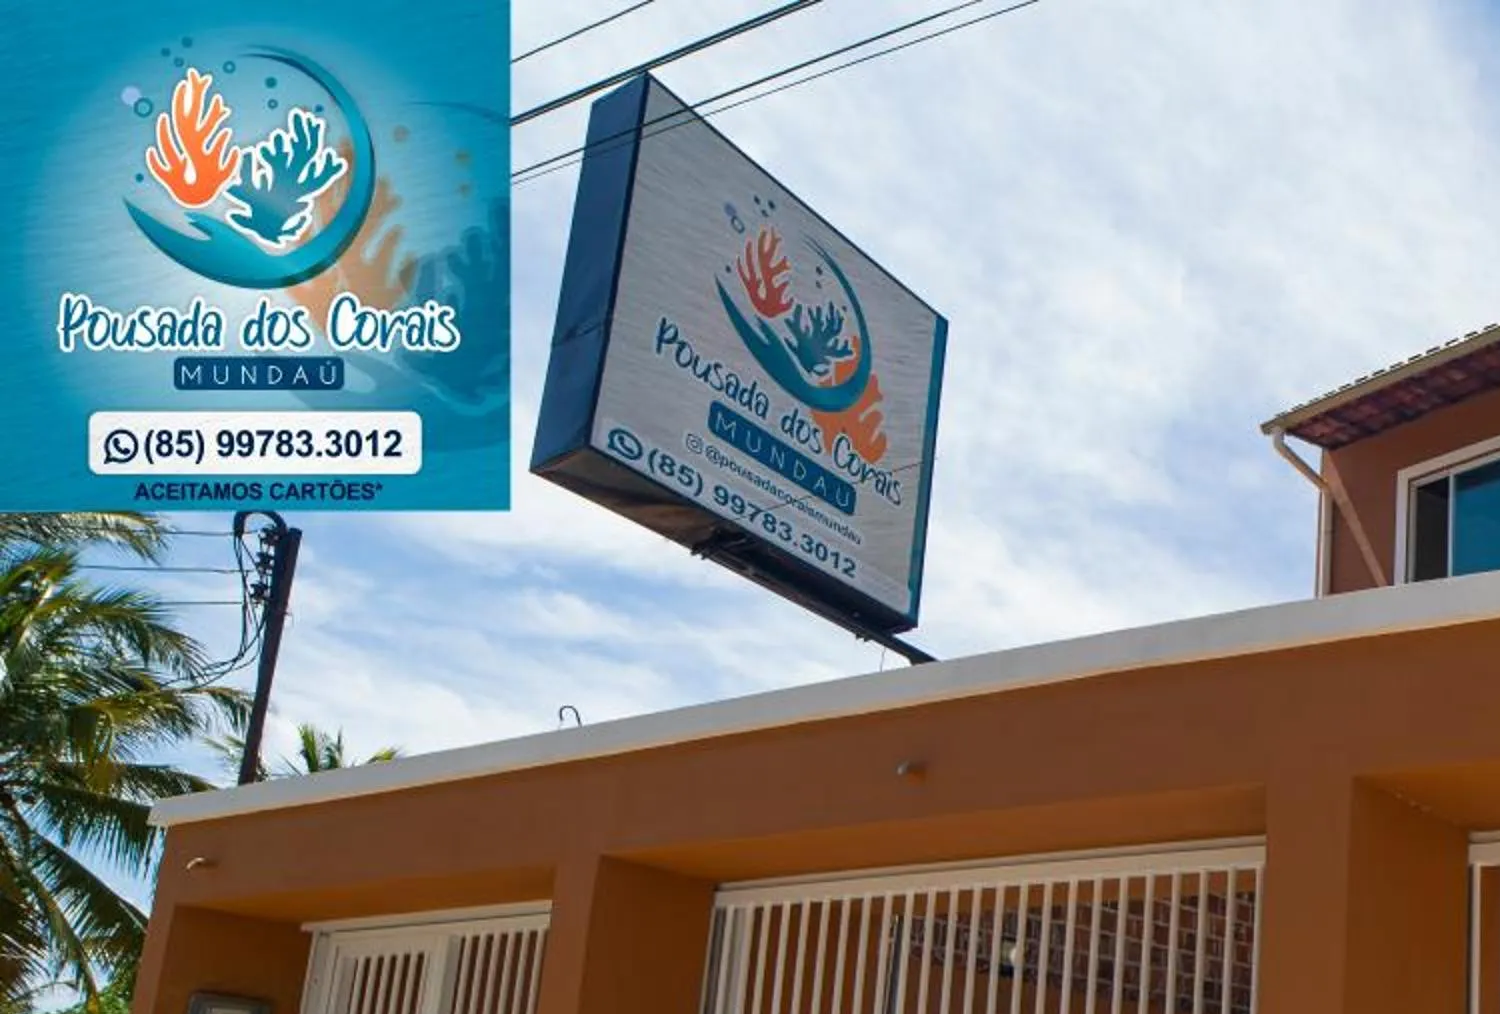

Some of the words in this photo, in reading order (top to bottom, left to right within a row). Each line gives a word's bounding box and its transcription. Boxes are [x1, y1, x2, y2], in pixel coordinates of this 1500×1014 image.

[656, 317, 770, 420] Pousada
[781, 408, 822, 454] dos
[833, 430, 901, 506] Corais
[648, 448, 703, 498] (85)
[713, 485, 857, 579] 99783.3012
